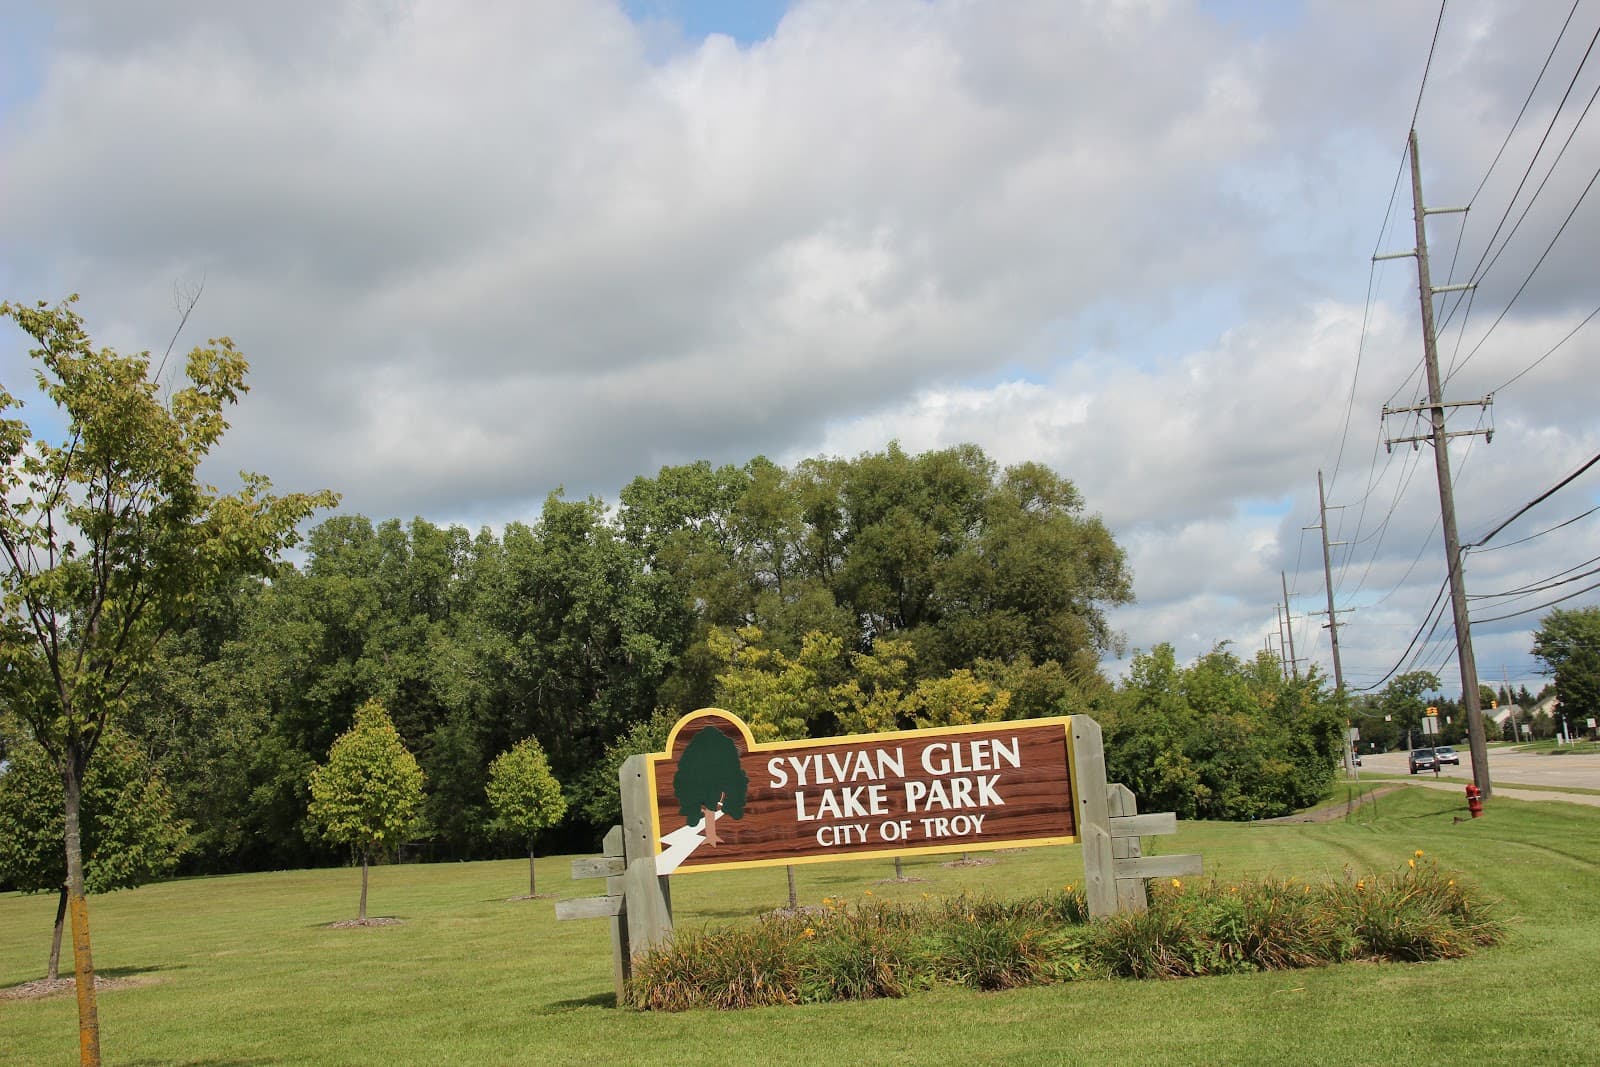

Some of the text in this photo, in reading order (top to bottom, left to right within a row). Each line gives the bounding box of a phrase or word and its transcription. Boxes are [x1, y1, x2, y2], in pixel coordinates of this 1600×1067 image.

[767, 737, 1021, 789] SYLVAN GLEN
[795, 774, 1005, 821] LAKE PARK
[816, 814, 986, 847] CITY OF TROY
